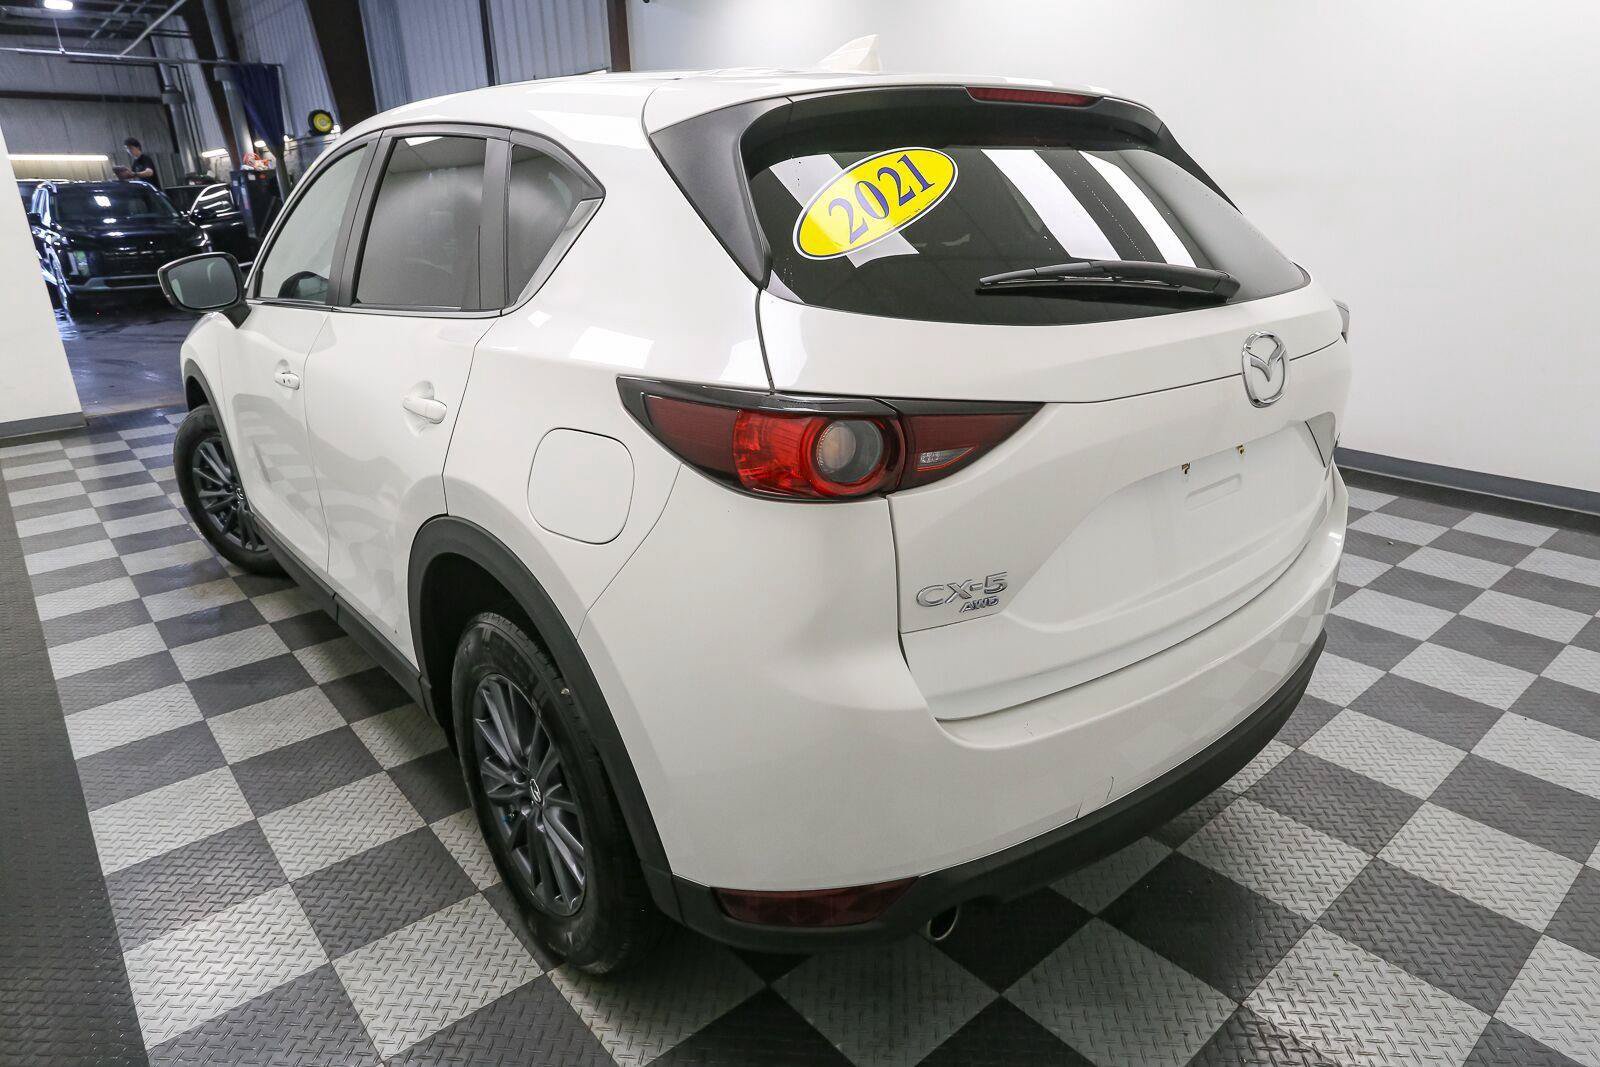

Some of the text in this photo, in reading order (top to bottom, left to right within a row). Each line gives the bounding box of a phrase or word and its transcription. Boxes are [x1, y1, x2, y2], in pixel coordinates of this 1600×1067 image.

[828, 154, 935, 244] 2021
[916, 571, 1008, 607] CX-5
[959, 596, 999, 613] AWD
